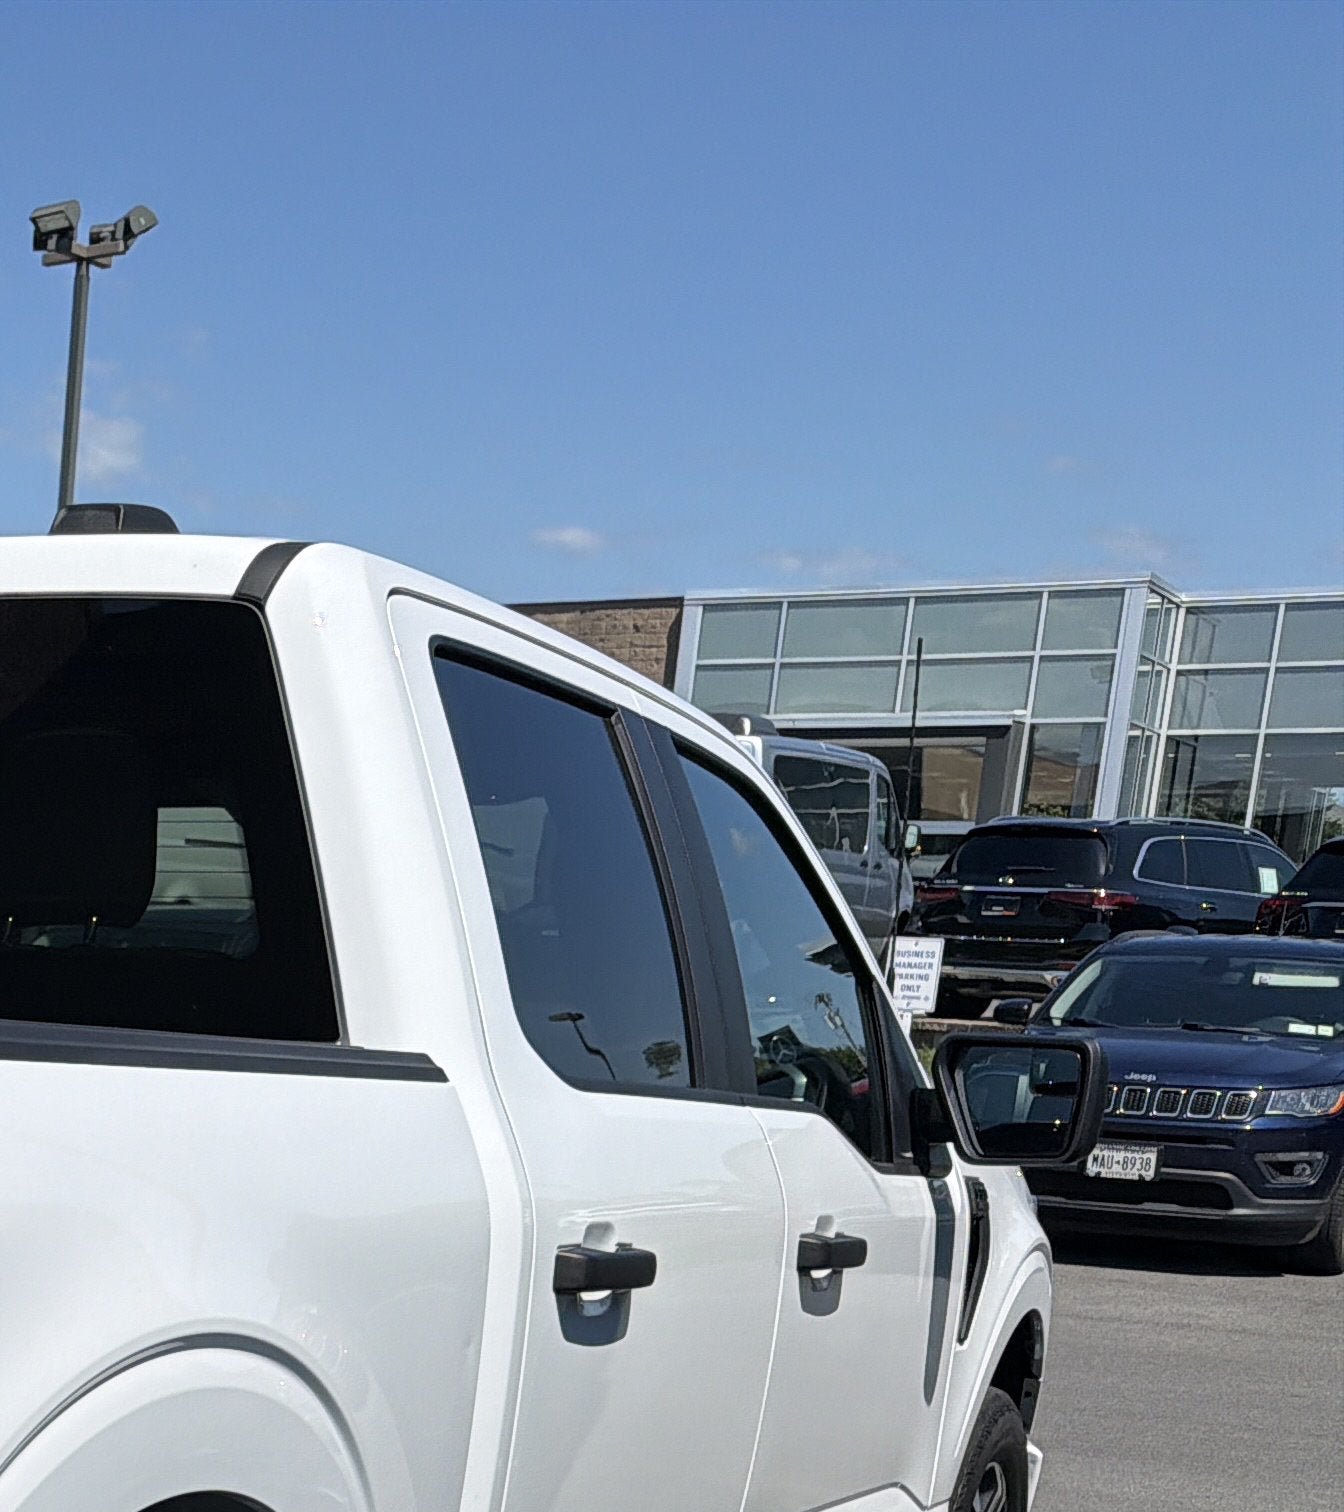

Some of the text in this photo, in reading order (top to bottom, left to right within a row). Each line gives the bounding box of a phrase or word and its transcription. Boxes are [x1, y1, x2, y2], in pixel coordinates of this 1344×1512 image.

[896, 950, 936, 959] BUSINESS
[895, 961, 934, 970] MANAGER
[900, 984, 921, 993] ONLY
[1123, 1071, 1157, 1083] Jeep
